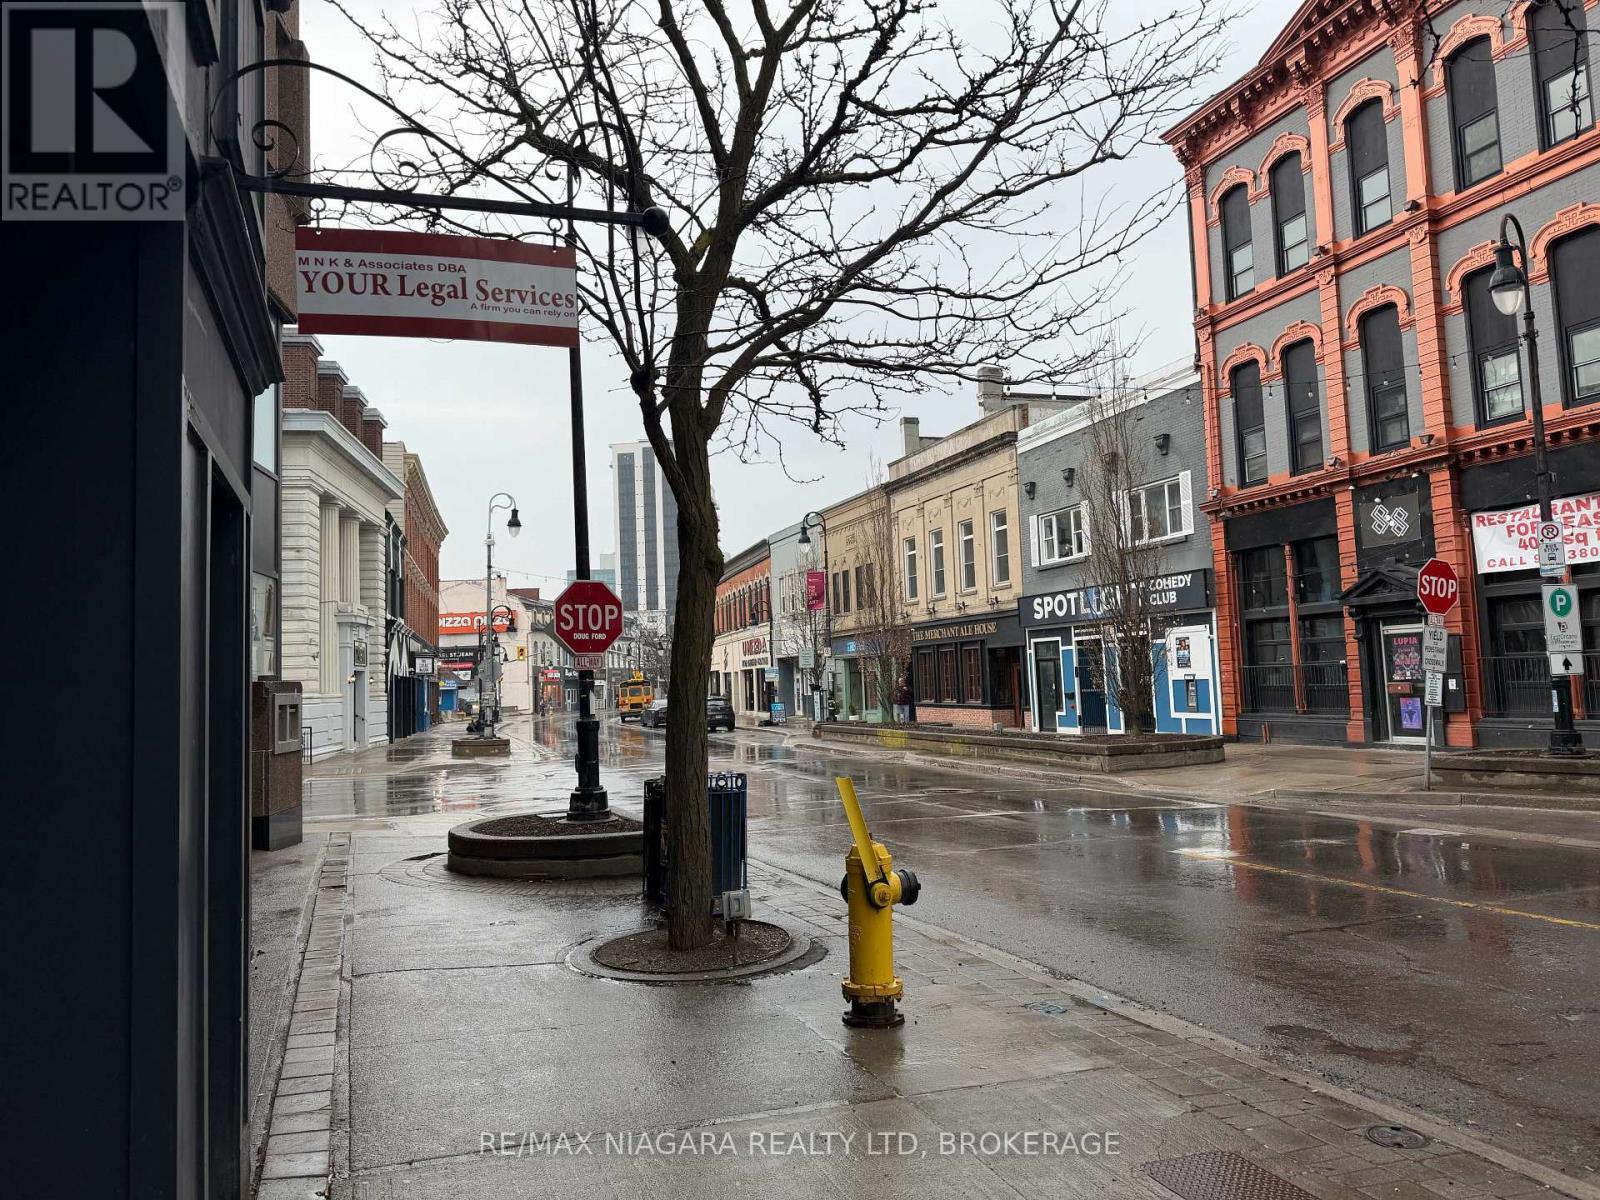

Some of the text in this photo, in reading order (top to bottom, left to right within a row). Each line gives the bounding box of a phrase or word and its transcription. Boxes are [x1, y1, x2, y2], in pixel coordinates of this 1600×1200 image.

[358, 259, 433, 272] Associates
[438, 263, 466, 273] DBA
[300, 270, 576, 309] YOUR Legal Services
[470, 303, 478, 311] A
[480, 303, 501, 312] firm
[503, 306, 521, 315] you
[544, 309, 562, 319] rely
[1563, 511, 1600, 529] EAS
[1486, 556, 1527, 568] CALL
[1149, 573, 1192, 591] COMEDY
[1420, 574, 1457, 599] STOP
[1149, 591, 1177, 606] CLUB
[439, 616, 471, 627] izza
[560, 603, 619, 631] STOP
[573, 632, 607, 640] DOUG FORD
[925, 626, 959, 640] MERCHANT
[960, 625, 973, 637] ALE
[975, 622, 997, 635] HOUSE
[1428, 629, 1444, 641] YIELD
